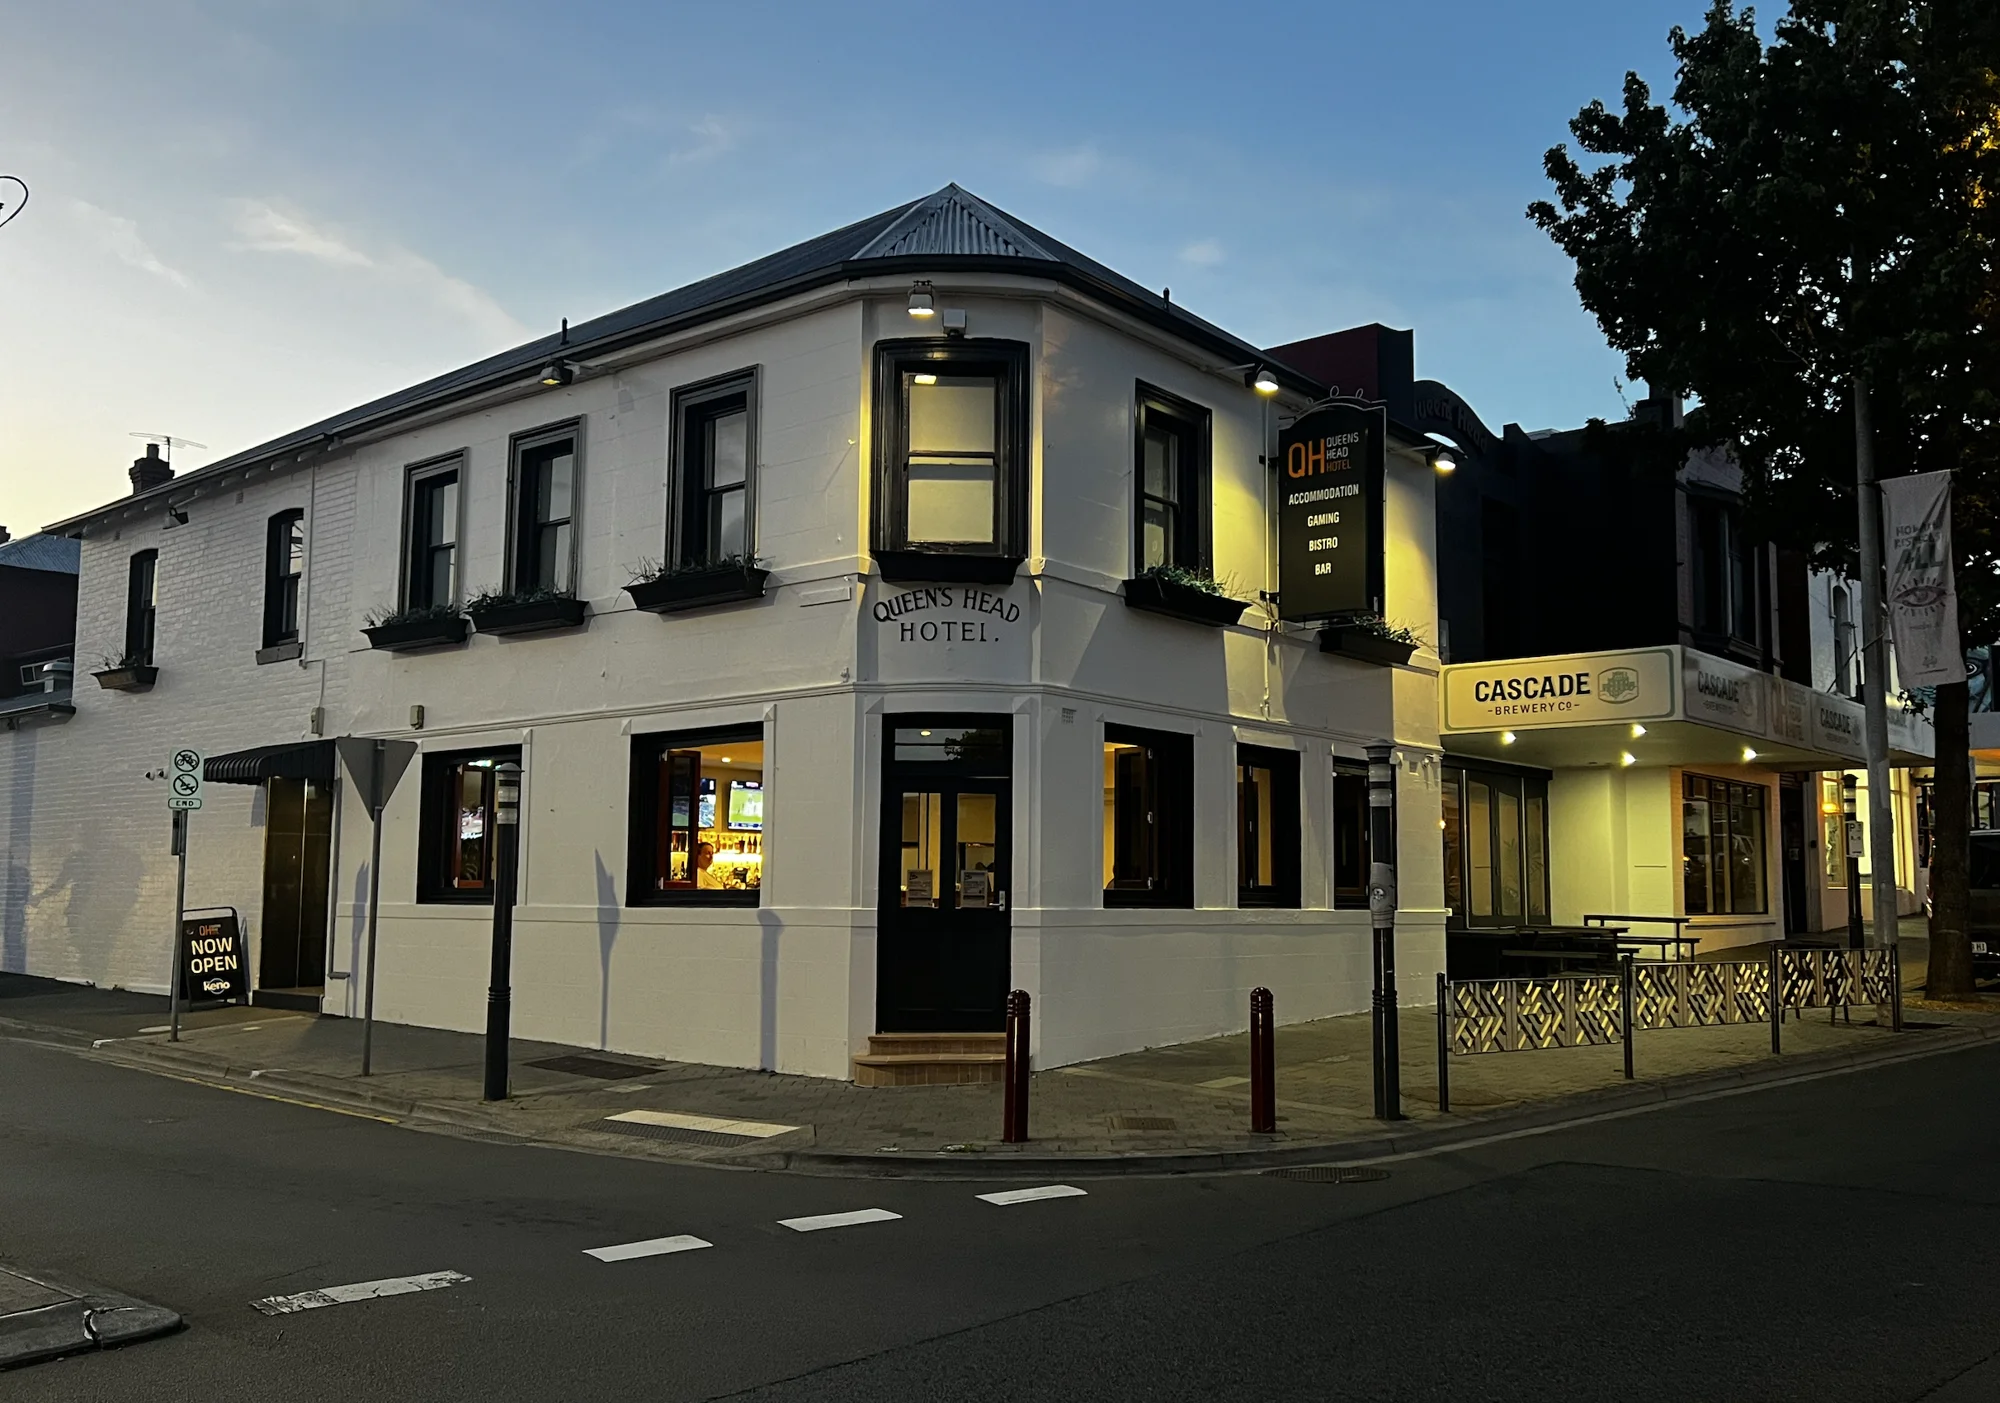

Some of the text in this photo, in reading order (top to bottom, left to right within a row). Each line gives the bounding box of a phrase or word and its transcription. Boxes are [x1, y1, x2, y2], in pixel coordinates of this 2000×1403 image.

[1458, 406, 1487, 454] Head
[1326, 432, 1359, 448] QUEENS
[1288, 438, 1325, 478] QH
[1326, 447, 1349, 459] HEAD
[1326, 458, 1351, 472] HOTEL
[1288, 483, 1359, 506] ACCOMMODATION
[1307, 512, 1340, 527] GAMING
[1308, 536, 1338, 551] BISTRO
[1315, 562, 1332, 576] BAR
[873, 587, 1020, 623] QUEEN'S HEAD
[1475, 672, 1591, 702] CASCADE
[1698, 671, 1739, 703] CASCADE
[1495, 702, 1555, 716] BREWERY
[191, 937, 232, 956] NOW
[191, 955, 237, 974] OPEN
